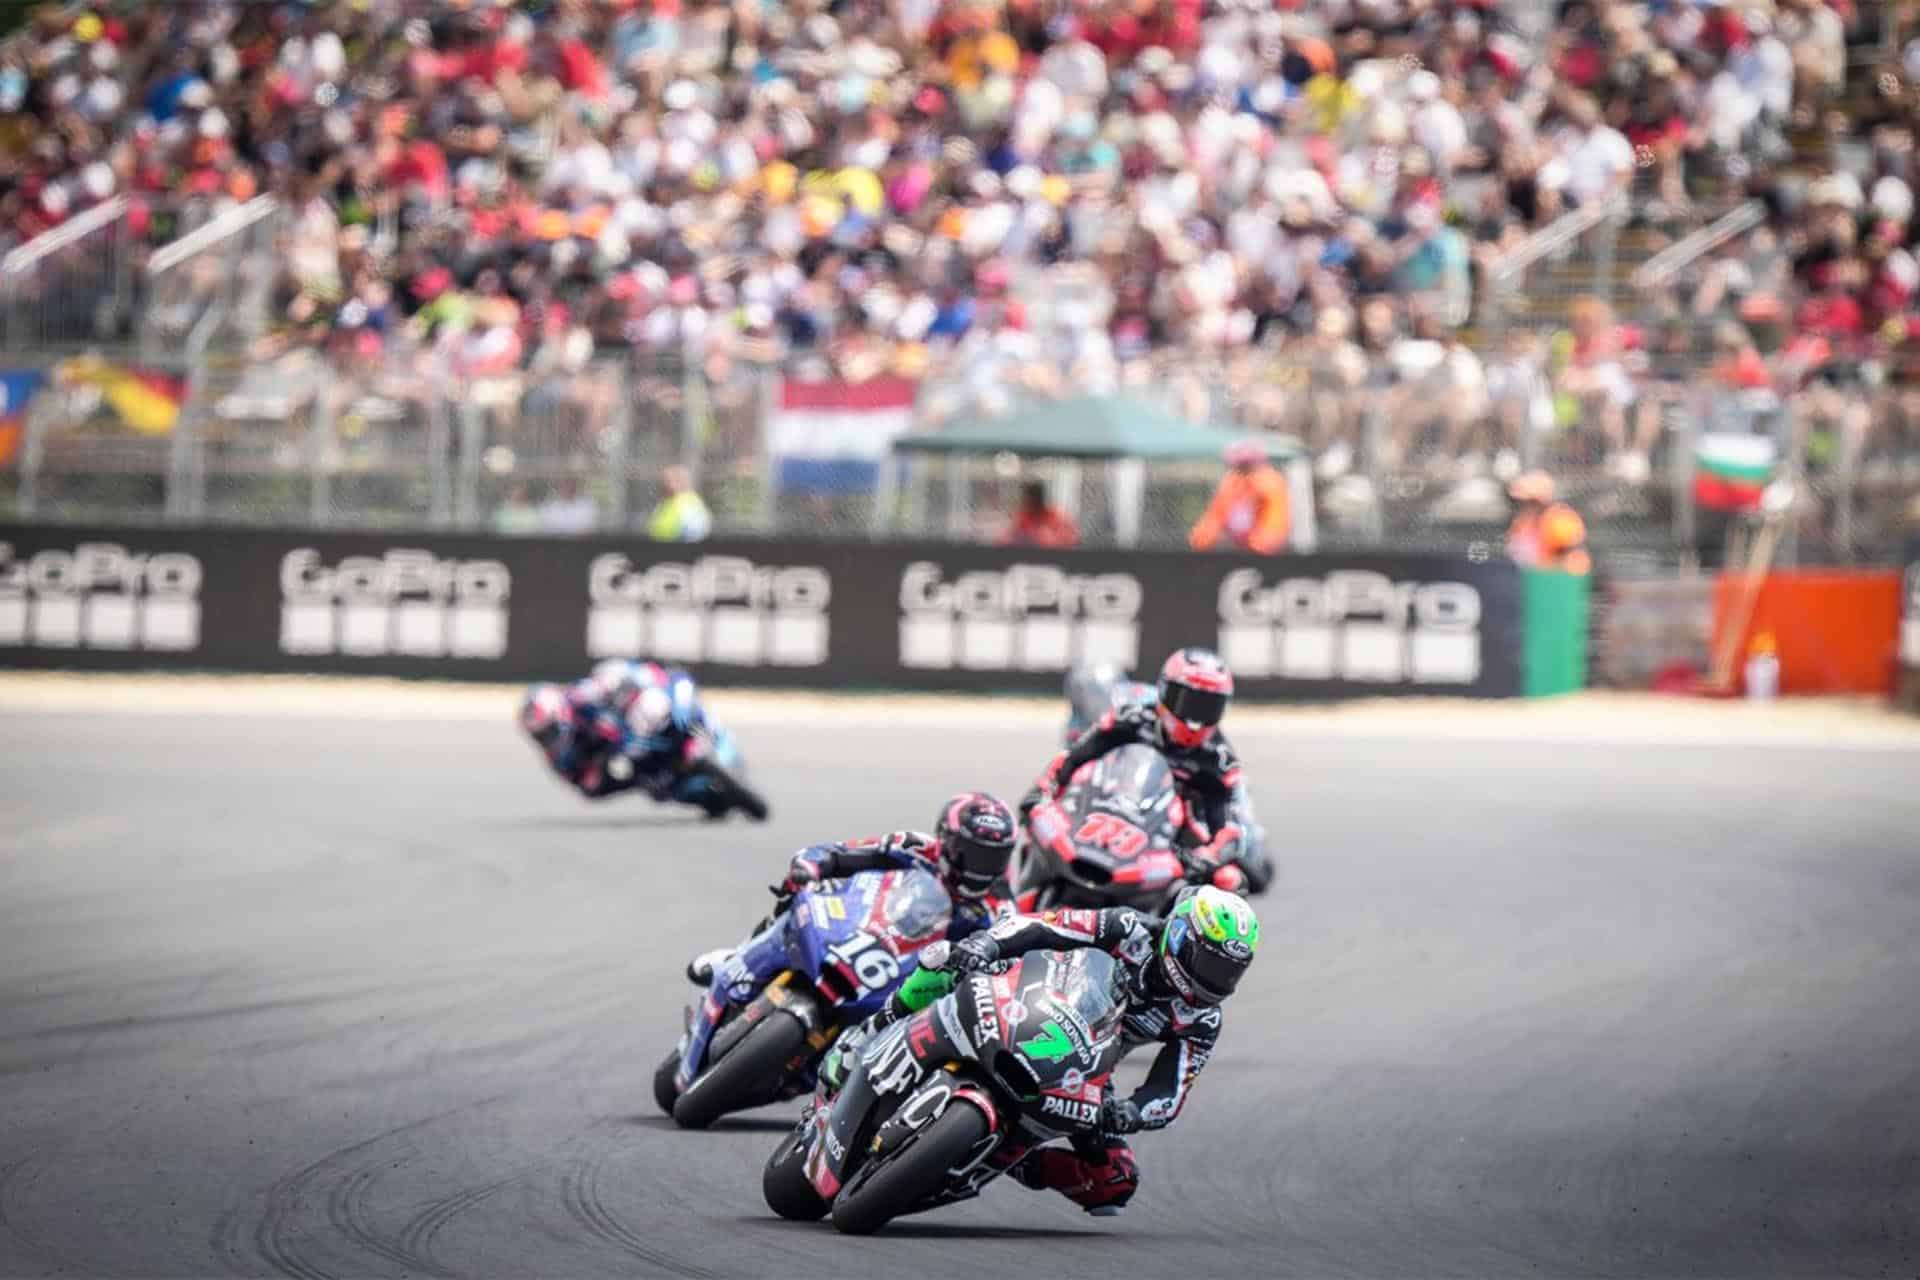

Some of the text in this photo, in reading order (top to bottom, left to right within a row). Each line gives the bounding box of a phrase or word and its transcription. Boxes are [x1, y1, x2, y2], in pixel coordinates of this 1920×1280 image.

[281, 548, 509, 602] GoPro
[589, 552, 831, 611] GoPro
[901, 561, 1142, 618] GoPro
[1217, 567, 1480, 632] GoPro
[828, 931, 899, 990] 16
[971, 977, 1000, 1043] PALLEX
[1016, 1018, 1076, 1064] 7
[1041, 1096, 1098, 1125] PALLEX
